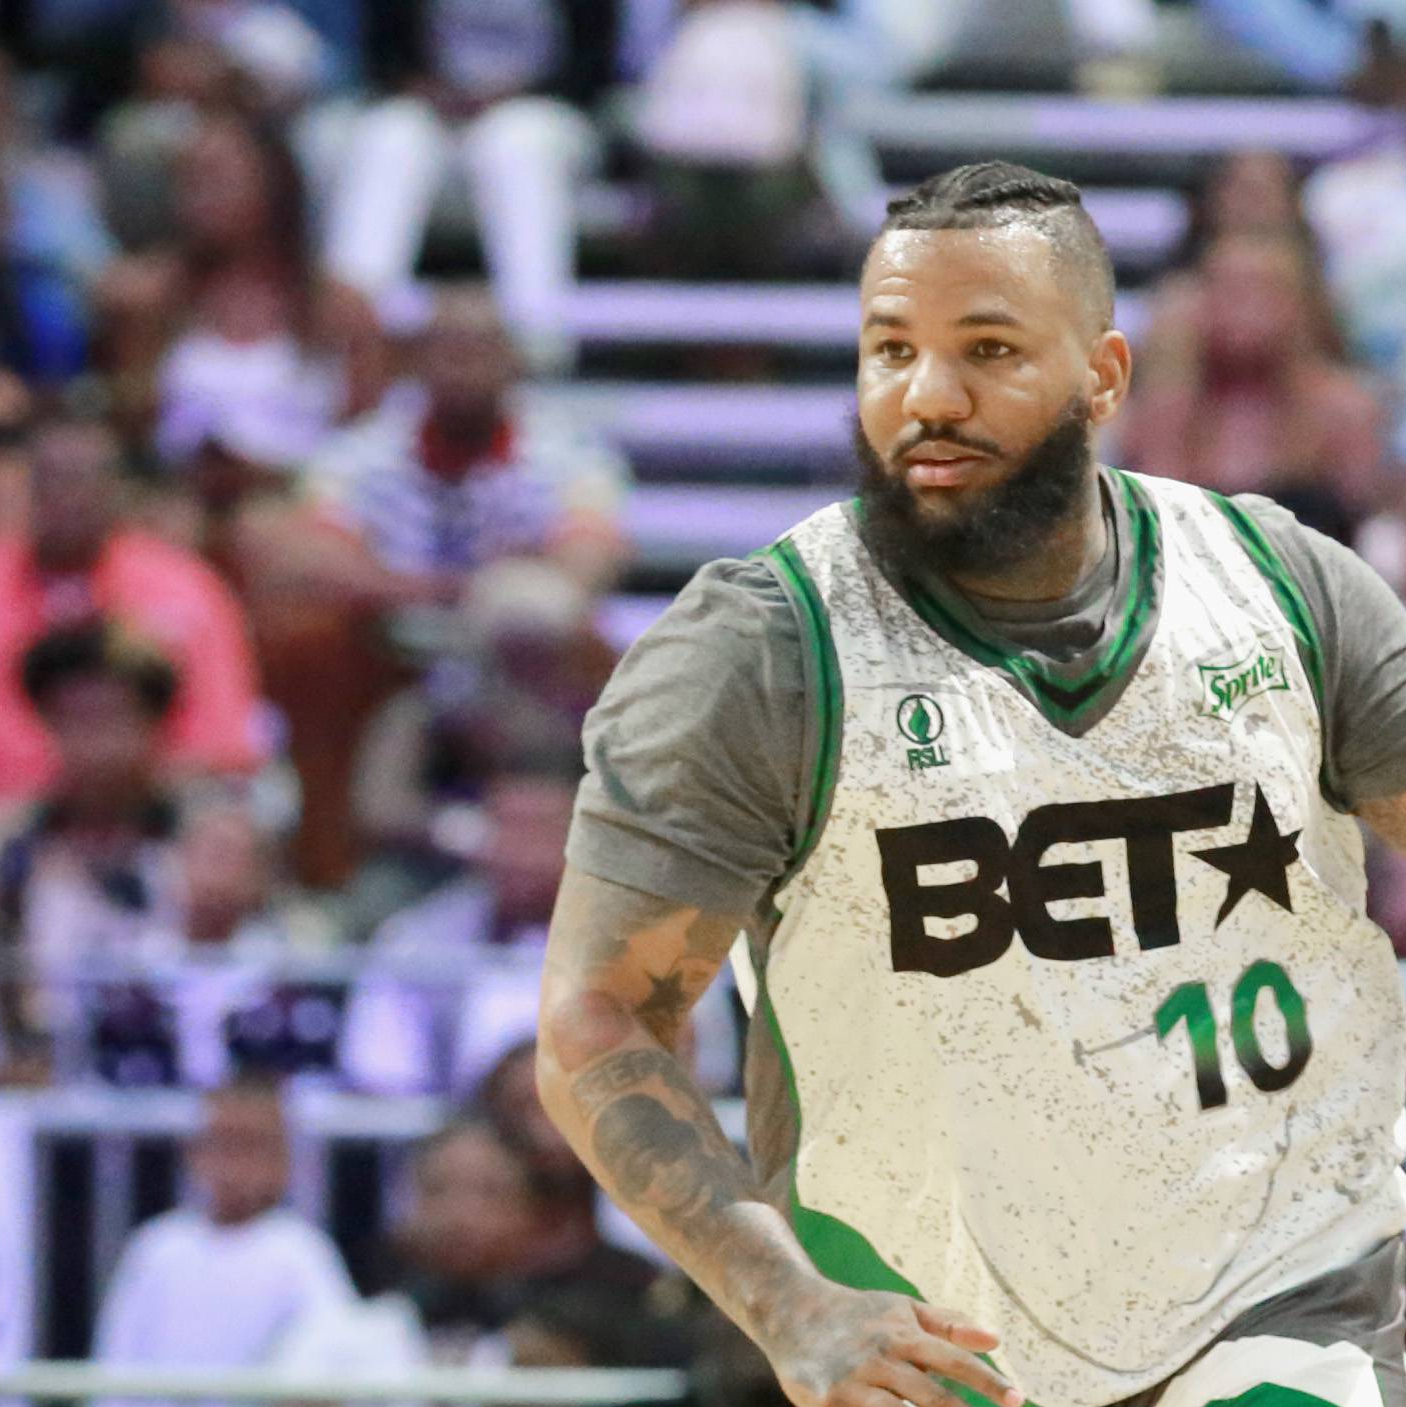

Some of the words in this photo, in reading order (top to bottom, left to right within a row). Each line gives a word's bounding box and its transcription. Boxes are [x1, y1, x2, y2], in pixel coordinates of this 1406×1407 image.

[1209, 655, 1277, 713] Sprite
[875, 782, 1236, 979] BET
[1153, 958, 1314, 1112] 10
